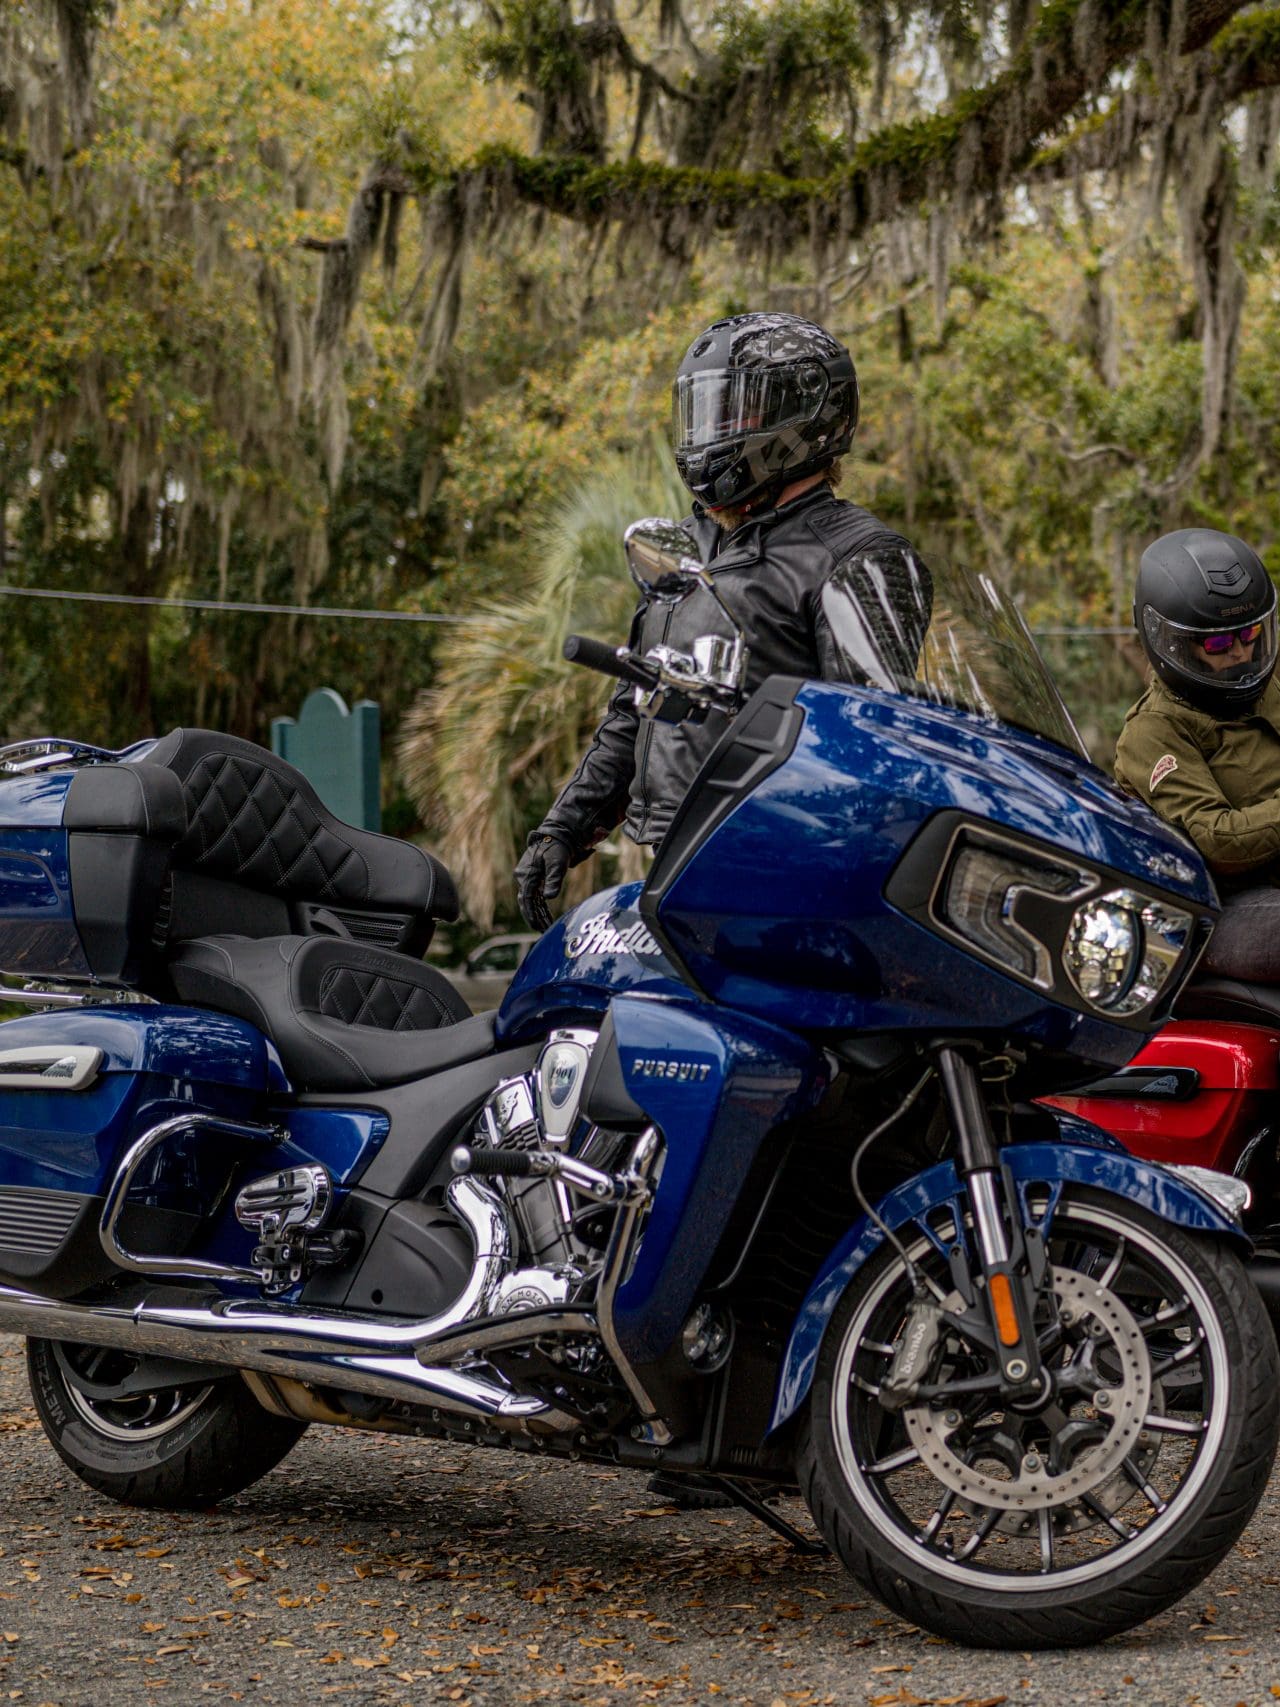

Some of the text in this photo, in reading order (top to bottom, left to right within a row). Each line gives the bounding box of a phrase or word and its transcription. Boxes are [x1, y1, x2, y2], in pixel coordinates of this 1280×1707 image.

[1219, 602, 1256, 617] SENA
[550, 1066, 573, 1079] 1901
[631, 1058, 711, 1081] PURSUIT
[900, 1322, 927, 1375] brembo
[34, 1340, 68, 1427] METZEL
